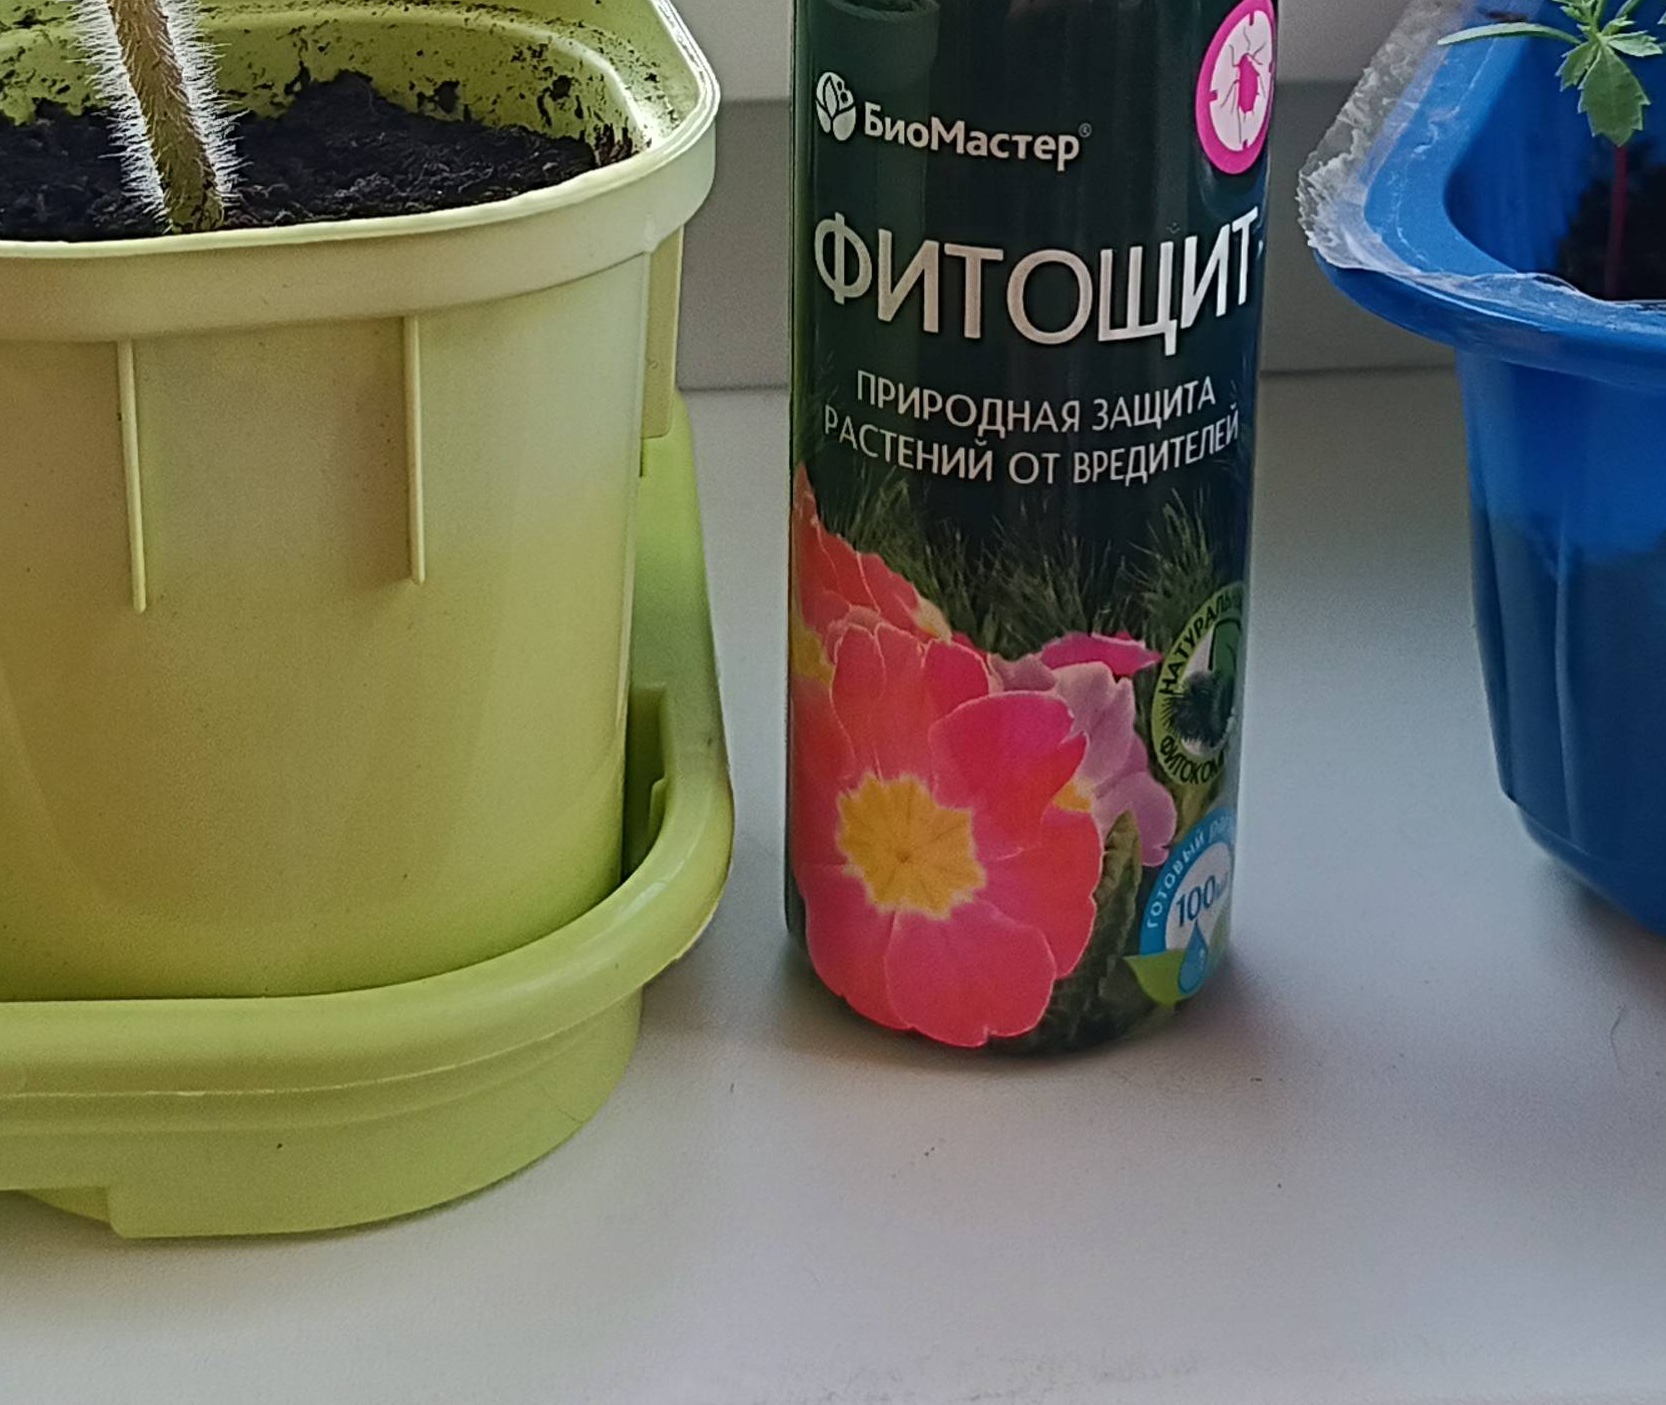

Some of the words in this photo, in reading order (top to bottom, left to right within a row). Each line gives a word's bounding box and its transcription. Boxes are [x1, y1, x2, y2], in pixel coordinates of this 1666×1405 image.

[863, 100, 1081, 172] БиоМастер
[813, 211, 1259, 357] ФИТОЩИТ
[857, 370, 1081, 439] ПРИРОДНАЯ
[1092, 376, 1217, 431] ЗАЩИТА
[824, 405, 994, 482] РАСТЕНИЙ
[1008, 452, 1061, 485] ОТ
[1073, 406, 1240, 487] ВРЕДИТЕЛЕЙ
[1146, 830, 1205, 929] ГОТОВЫЙ
